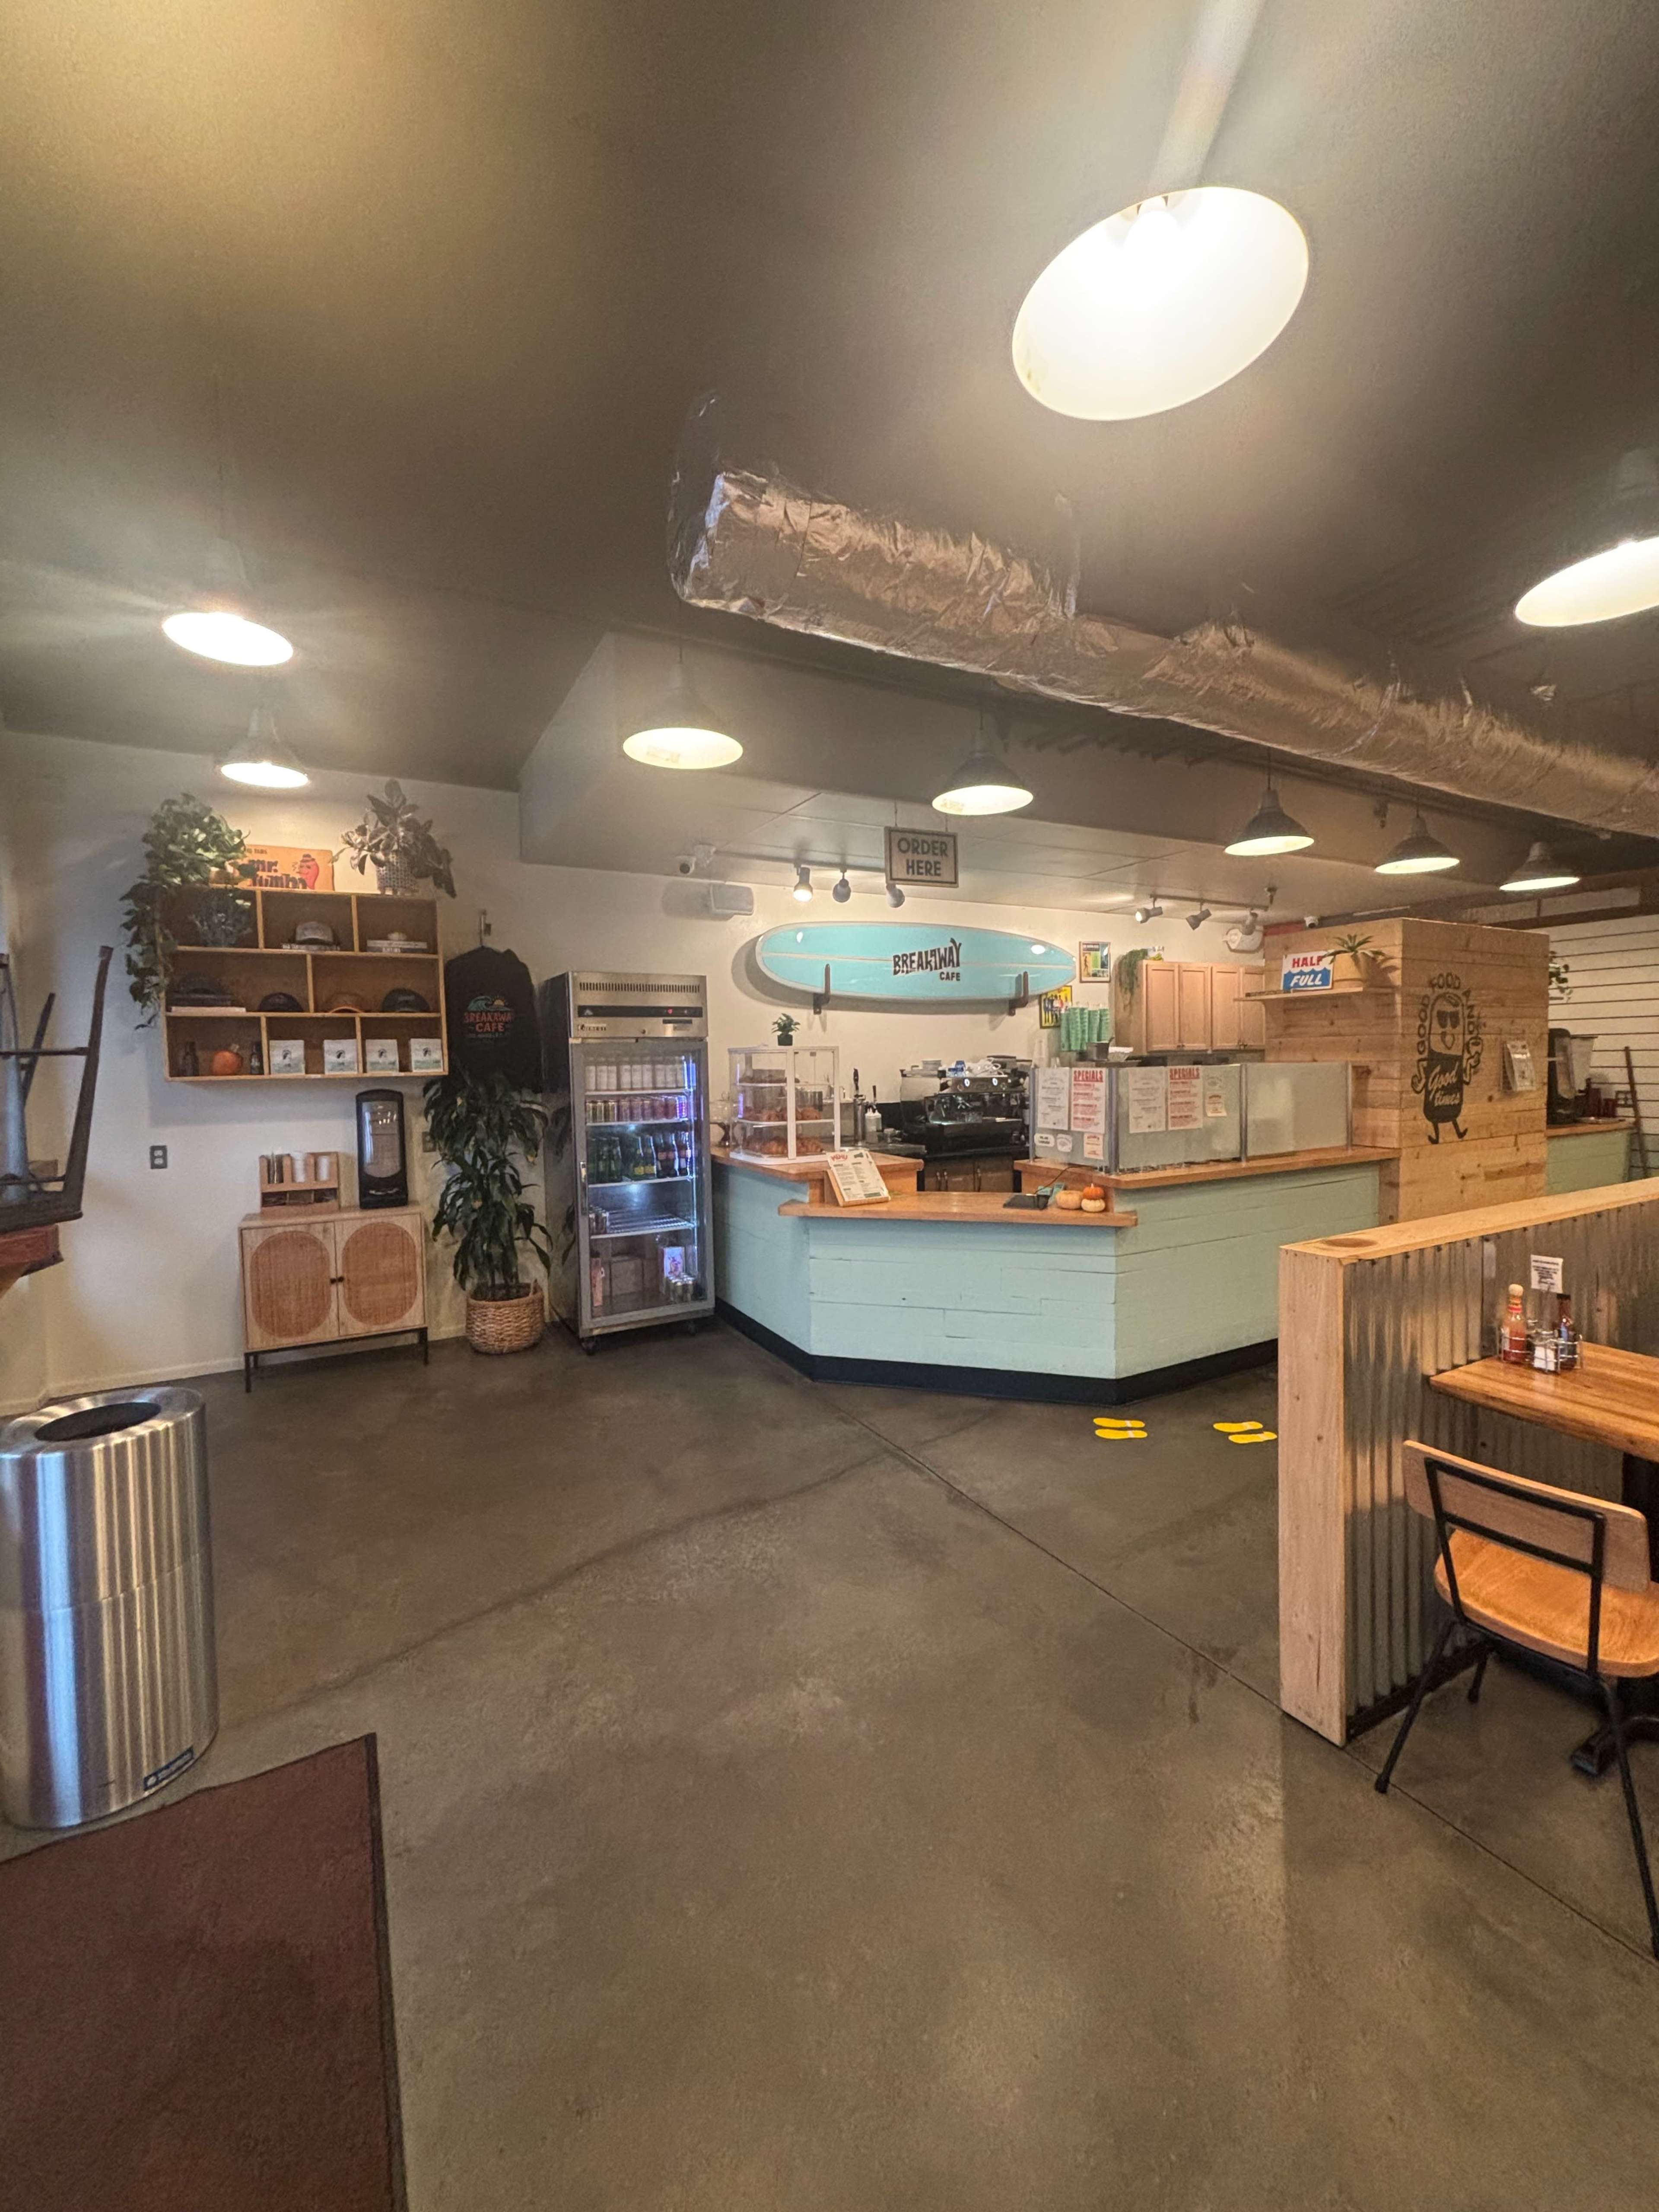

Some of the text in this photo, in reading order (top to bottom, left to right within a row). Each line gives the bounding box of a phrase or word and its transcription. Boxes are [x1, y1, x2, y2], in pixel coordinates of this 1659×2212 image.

[897, 837, 948, 857] ORDER
[906, 859, 941, 877] HERE
[893, 938, 962, 976] BREAKAWAY
[1292, 955, 1323, 968] HALF
[939, 972, 960, 981] CAFE
[1290, 973, 1322, 987] FULL
[1417, 994, 1430, 1055] GOOD
[1430, 972, 1461, 993] FOOD
[476, 1023, 505, 1032] CAFE
[1074, 1070, 1103, 1081] SPECIALS
[1170, 1068, 1200, 1079] SPECIALS
[1428, 1062, 1459, 1101] Good
[1434, 1092, 1460, 1107] times
